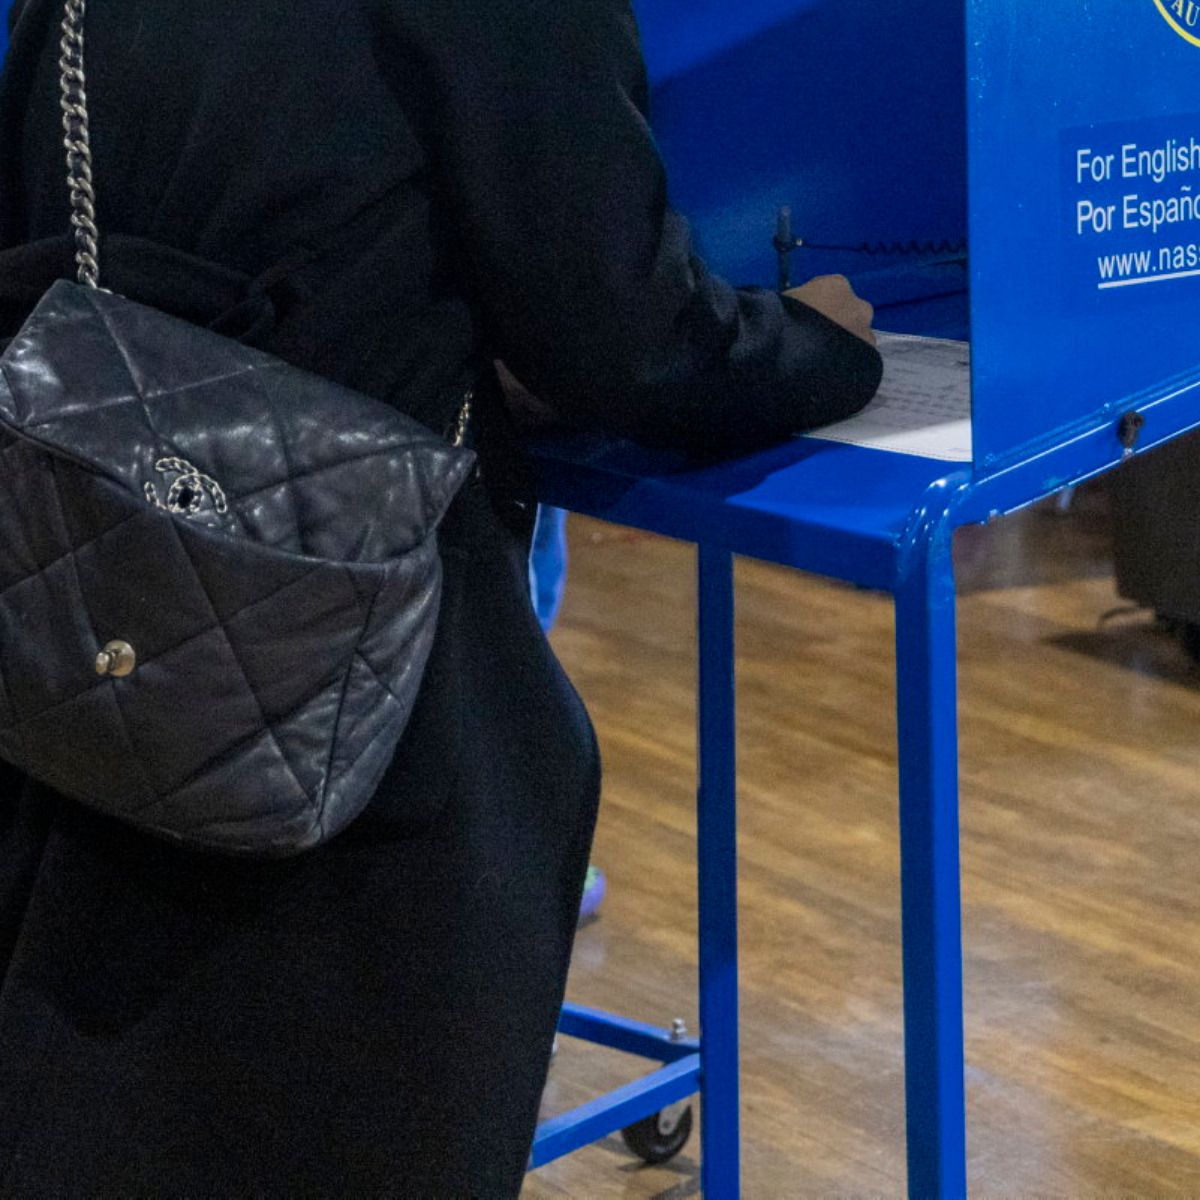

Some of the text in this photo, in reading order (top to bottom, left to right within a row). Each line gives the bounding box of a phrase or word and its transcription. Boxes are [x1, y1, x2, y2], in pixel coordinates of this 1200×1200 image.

[1077, 137, 1200, 184] For English
[1077, 200, 1116, 235] Por
[1098, 243, 1200, 279] www.nas
